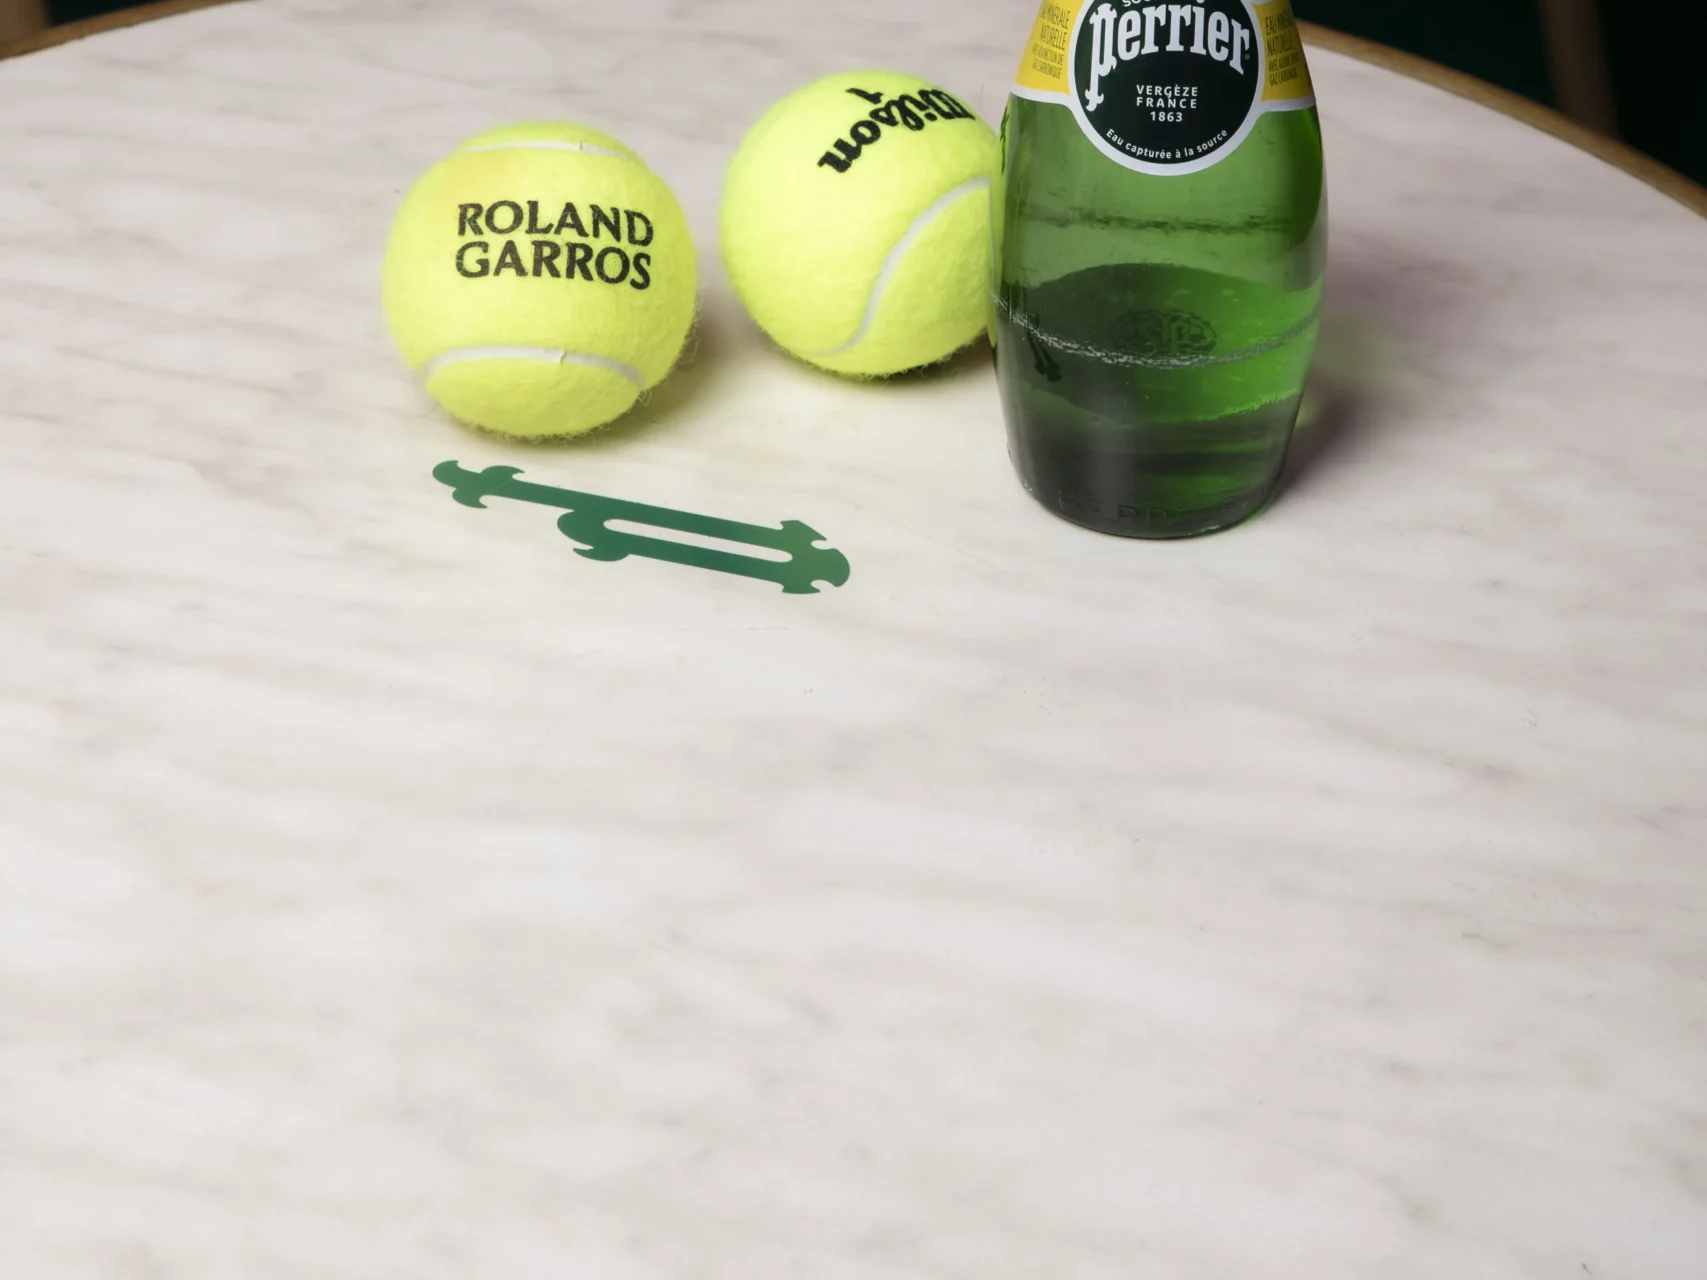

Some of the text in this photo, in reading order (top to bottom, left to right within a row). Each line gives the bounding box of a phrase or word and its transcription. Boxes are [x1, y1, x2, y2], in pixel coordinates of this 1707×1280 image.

[1136, 84, 1198, 99] VERGÈZE
[1136, 97, 1198, 109] FRANCE
[817, 87, 976, 174] Wilson
[1150, 111, 1183, 123] 1863
[1106, 128, 1229, 160] Eau capturée à la source
[457, 199, 655, 247] ROLAND
[455, 240, 652, 291] GARROS
